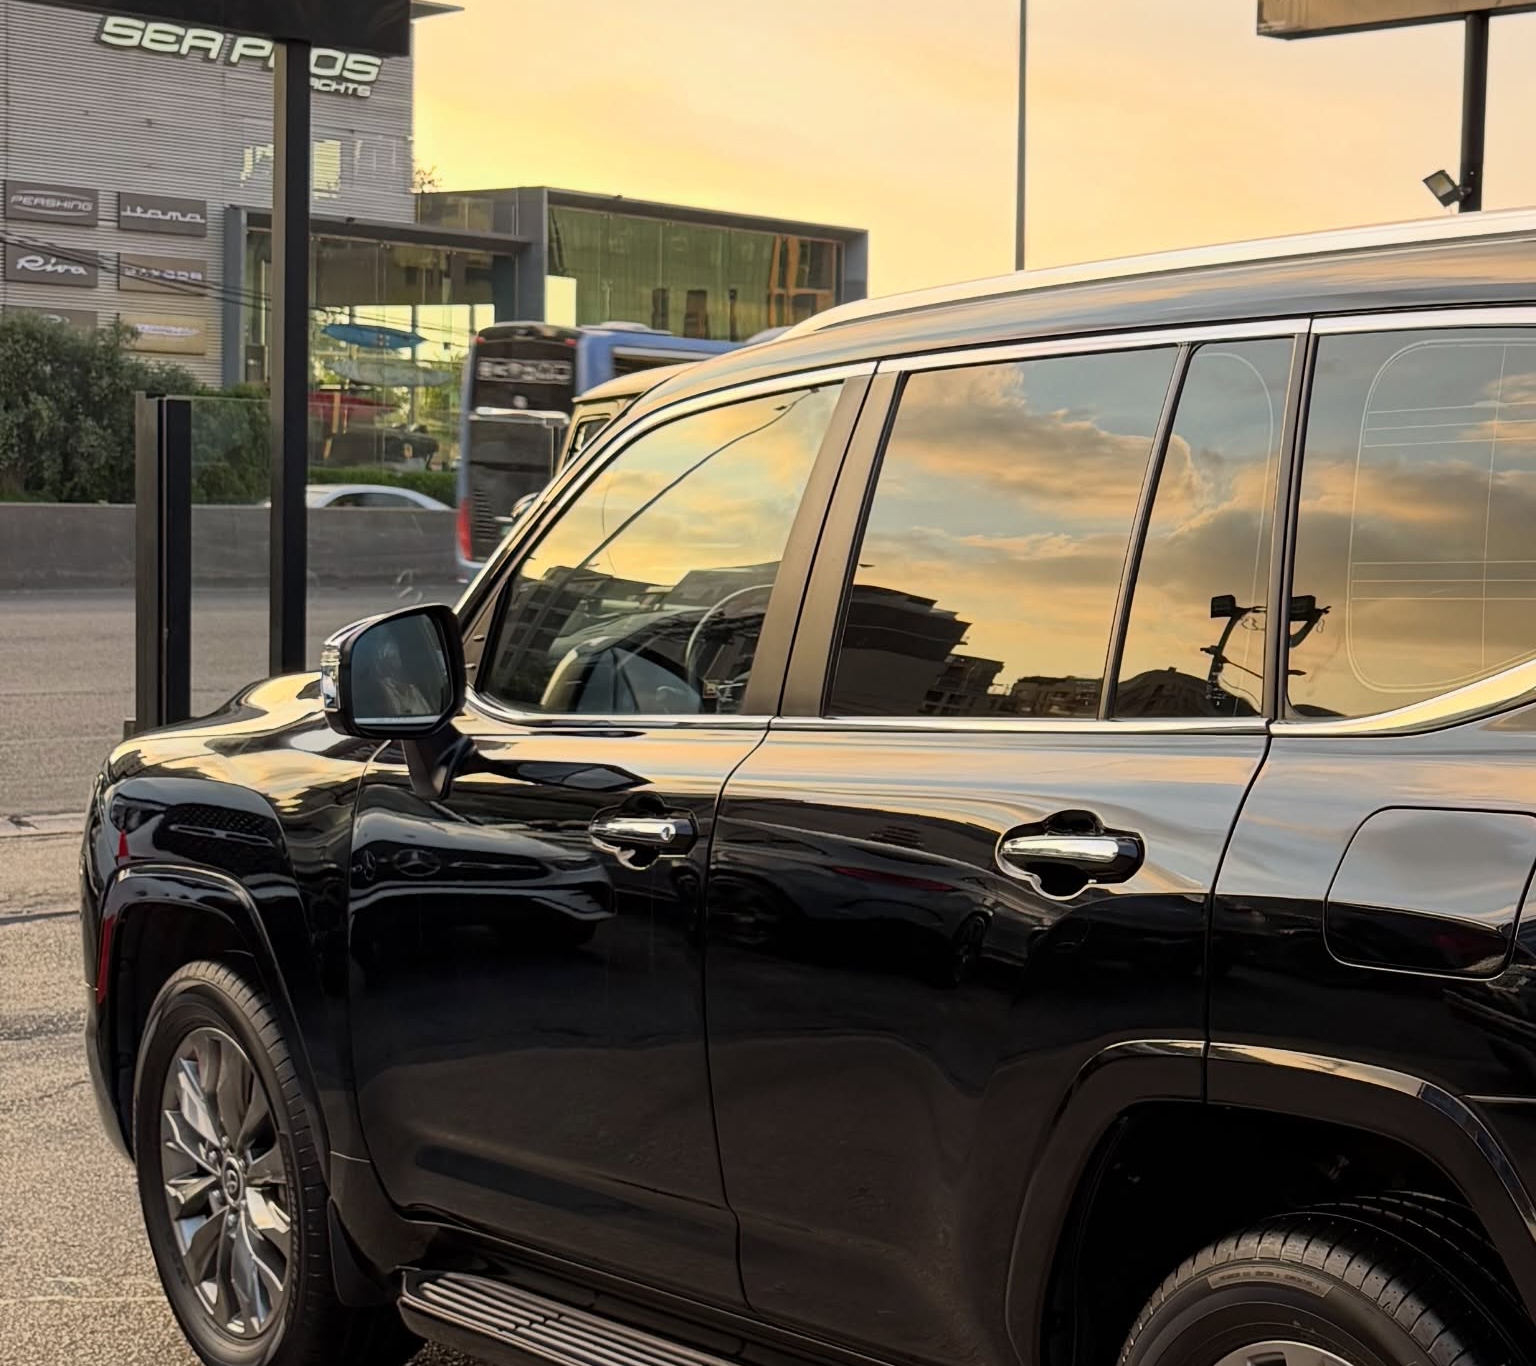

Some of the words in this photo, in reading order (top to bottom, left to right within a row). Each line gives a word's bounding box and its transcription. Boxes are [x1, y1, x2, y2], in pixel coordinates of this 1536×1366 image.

[100, 15, 224, 59] SEA
[11, 195, 93, 212] PERSHING
[16, 255, 88, 276] Riva
